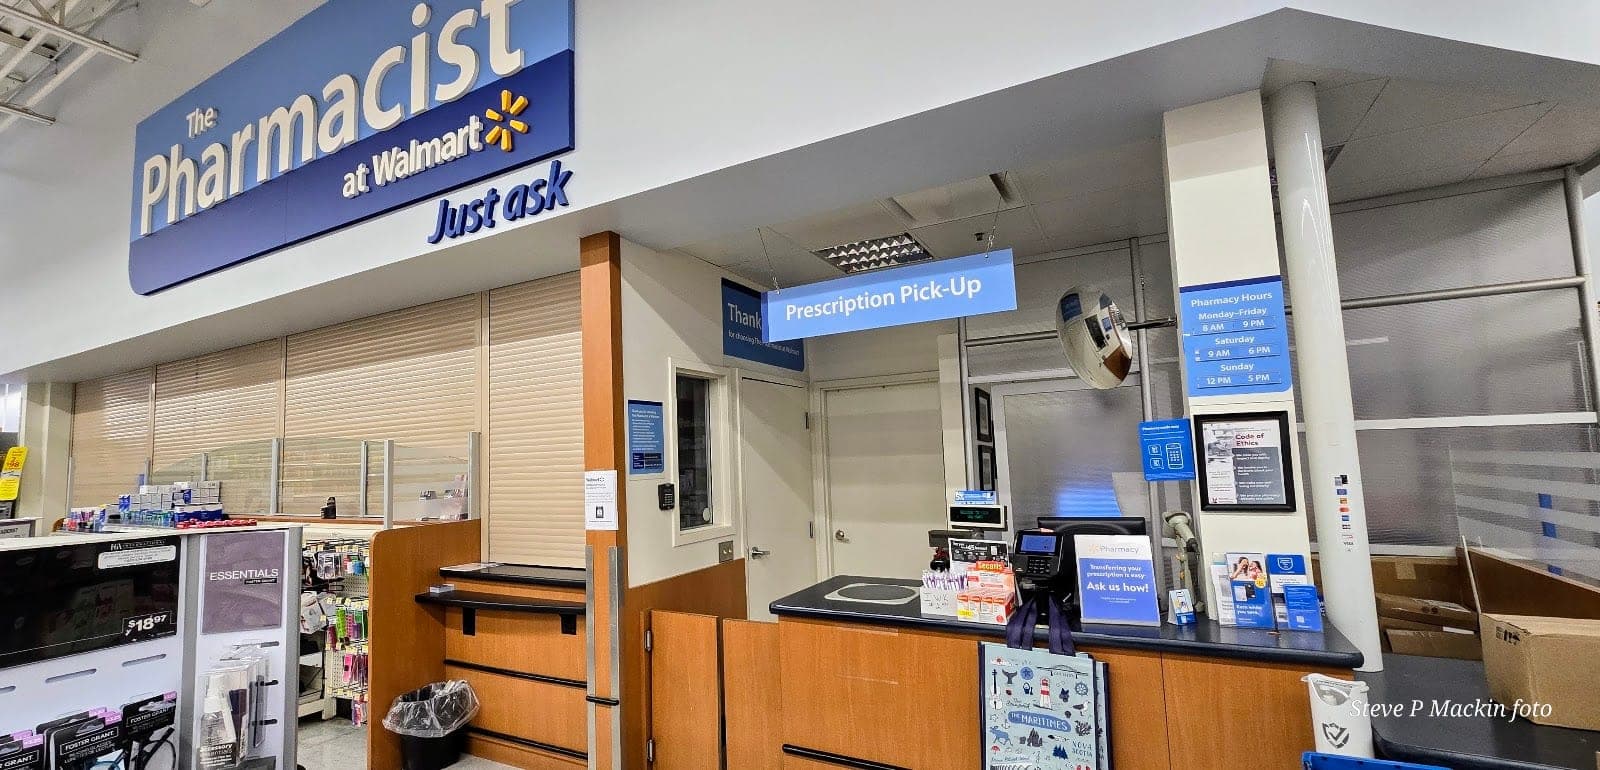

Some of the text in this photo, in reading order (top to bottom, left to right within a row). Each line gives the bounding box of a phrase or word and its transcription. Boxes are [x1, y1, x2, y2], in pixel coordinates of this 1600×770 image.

[140, 0, 524, 237] Pharmacist
[186, 106, 218, 139] The
[342, 114, 484, 199] at Walmart
[427, 159, 574, 244] Just ask
[786, 275, 982, 321] Prescription Pick-Up
[1190, 292, 1273, 308] Pharmacy Hours
[1210, 323, 1225, 331] AM
[1243, 320, 1249, 328] 9
[1250, 319, 1265, 327] PM
[1215, 335, 1255, 345] Saturday
[1208, 350, 1214, 358] 9
[1215, 349, 1231, 357] AM
[1220, 363, 1255, 372] Sunday
[1206, 377, 1216, 385] 12
[1217, 376, 1232, 384] PM
[1100, 545, 1139, 554] Pharmacy
[209, 568, 279, 581] ESSENTIALS
[1090, 564, 1127, 572] Transferring
[1086, 582, 1106, 591] Ask
[1122, 582, 1149, 593] how!
[1021, 714, 1068, 730] MARITIMES
[65, 730, 115, 751] FOSTER GRANT
[1072, 740, 1092, 750] NOVA
[4, 754, 34, 767] GRANT
